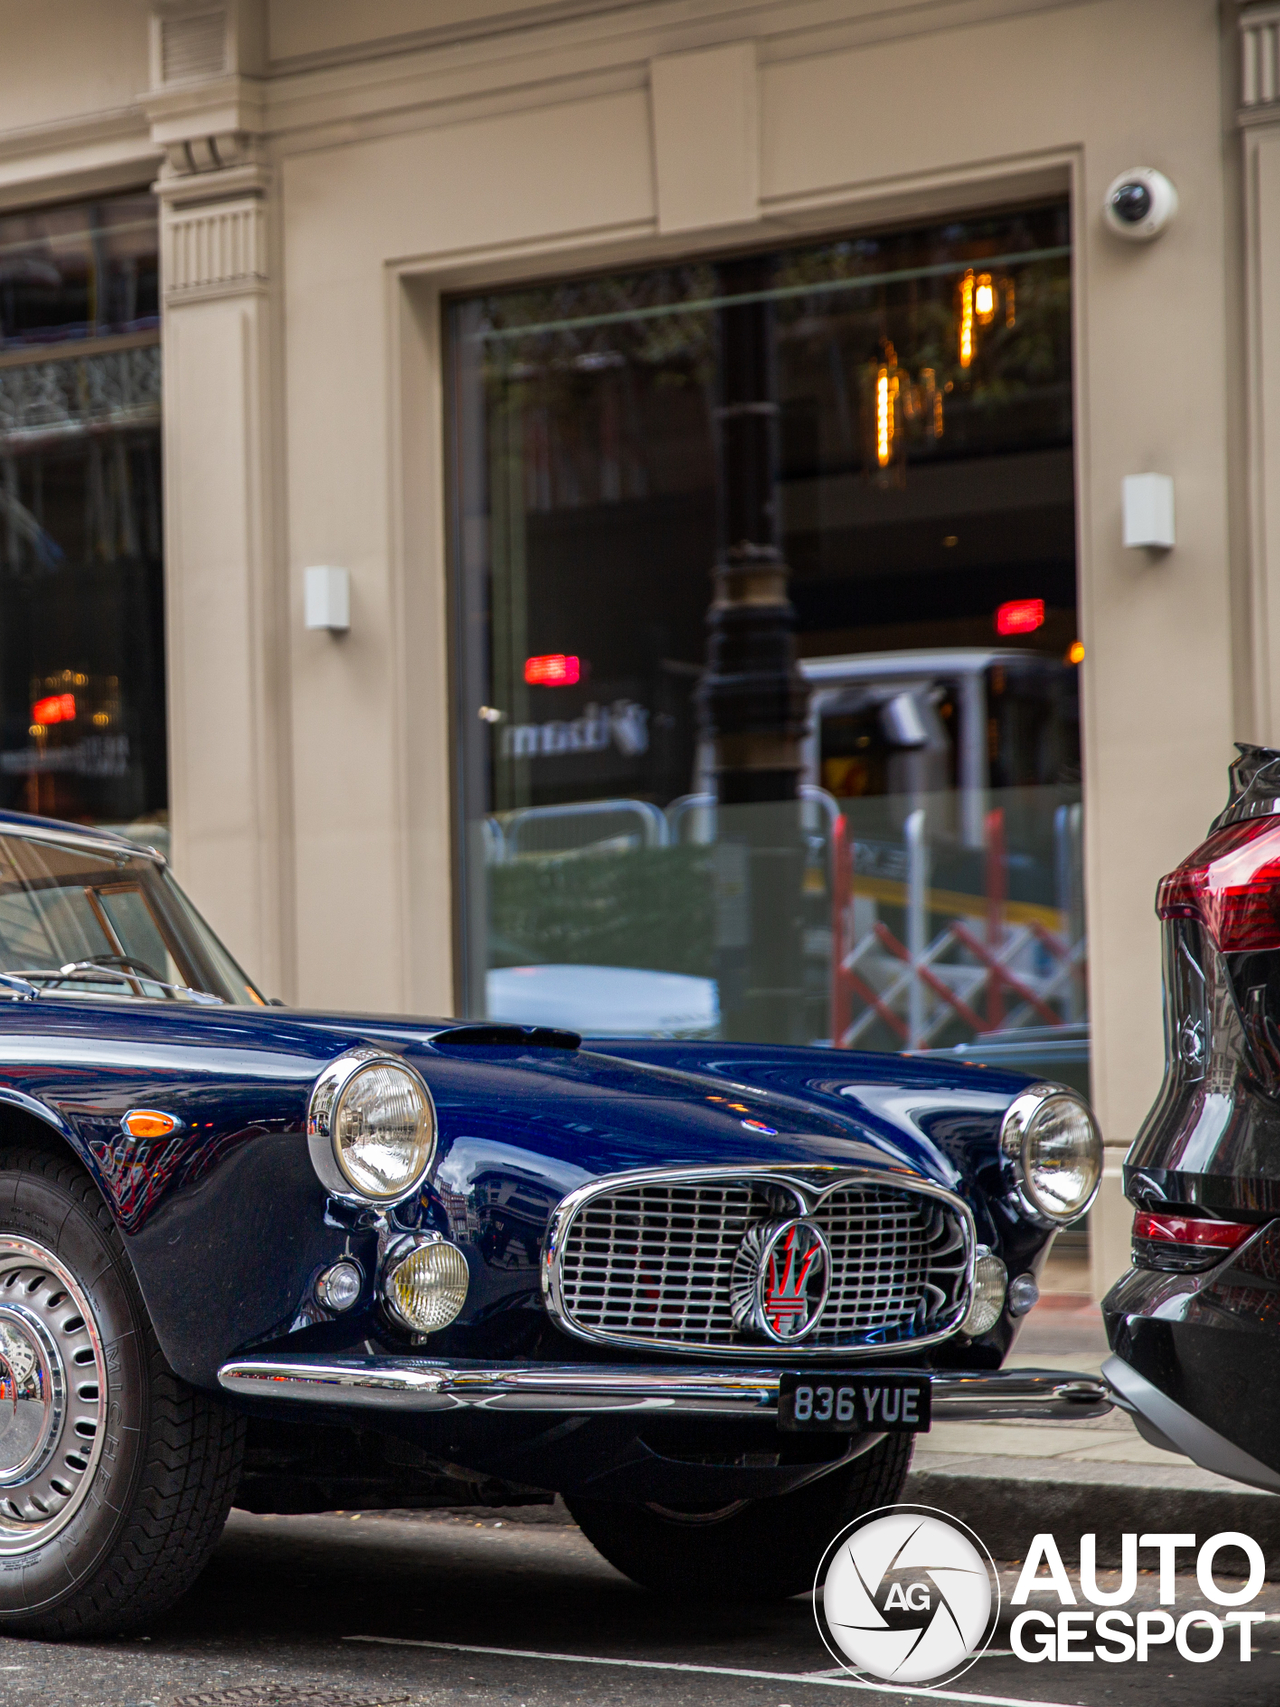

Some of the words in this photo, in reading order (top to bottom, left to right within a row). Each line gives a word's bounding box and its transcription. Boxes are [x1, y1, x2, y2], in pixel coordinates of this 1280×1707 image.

[58, 1344, 122, 1557] MICHELIN
[795, 1386, 856, 1421] 836
[862, 1387, 920, 1423] YUE
